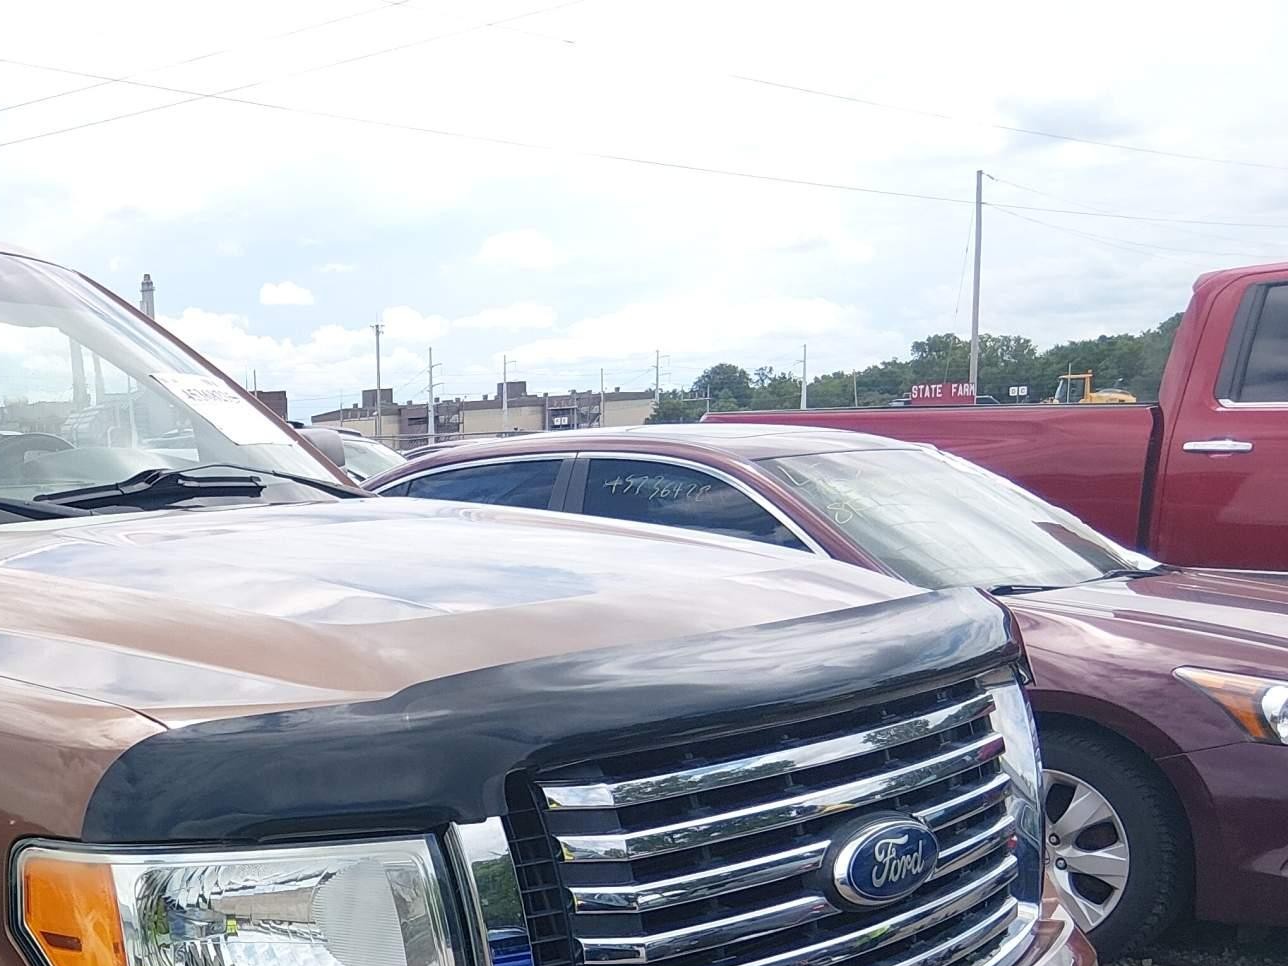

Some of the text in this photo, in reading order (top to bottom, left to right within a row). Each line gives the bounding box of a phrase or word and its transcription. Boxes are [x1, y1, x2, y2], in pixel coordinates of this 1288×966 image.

[912, 383, 976, 399] STATE FARM
[872, 834, 925, 888] Ford
